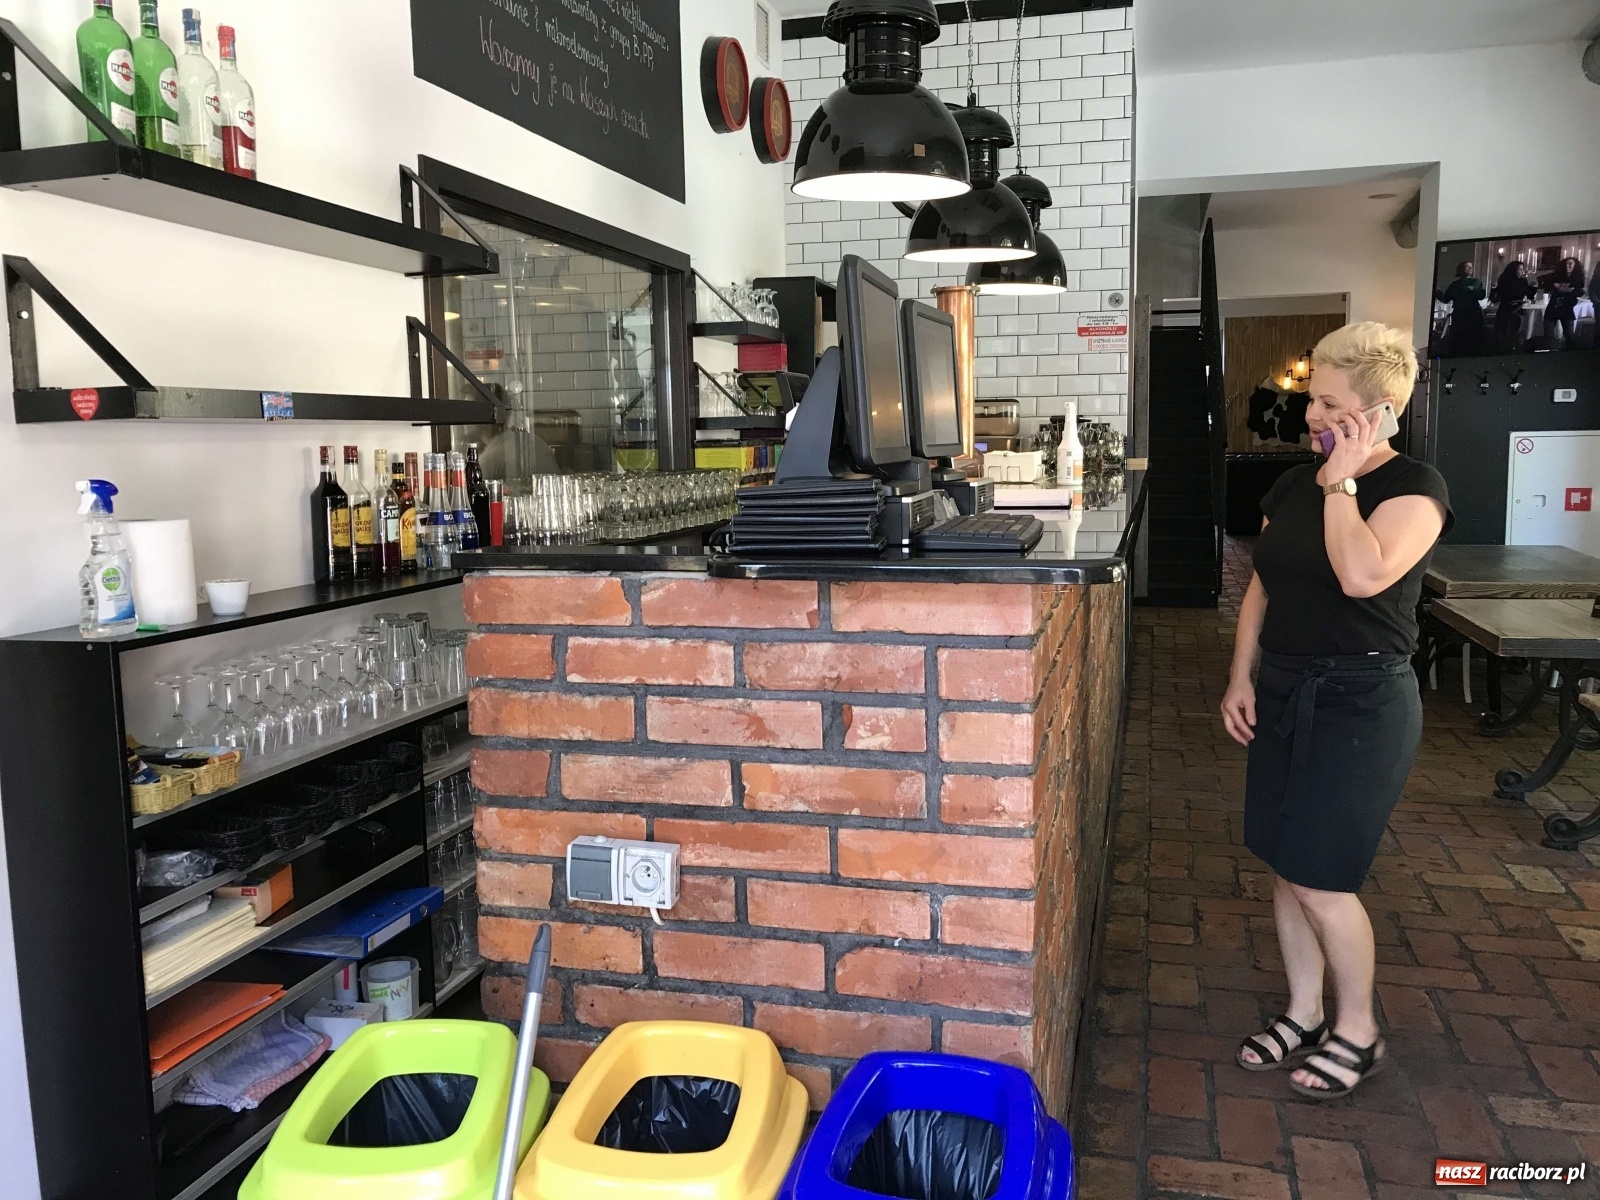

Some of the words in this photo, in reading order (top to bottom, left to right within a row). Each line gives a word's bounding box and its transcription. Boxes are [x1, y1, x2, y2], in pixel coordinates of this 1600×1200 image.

[480, 15, 541, 106] Warzymy
[548, 63, 558, 108] je
[562, 82, 575, 105] na
[601, 17, 607, 34] z
[609, 25, 631, 60] grupy
